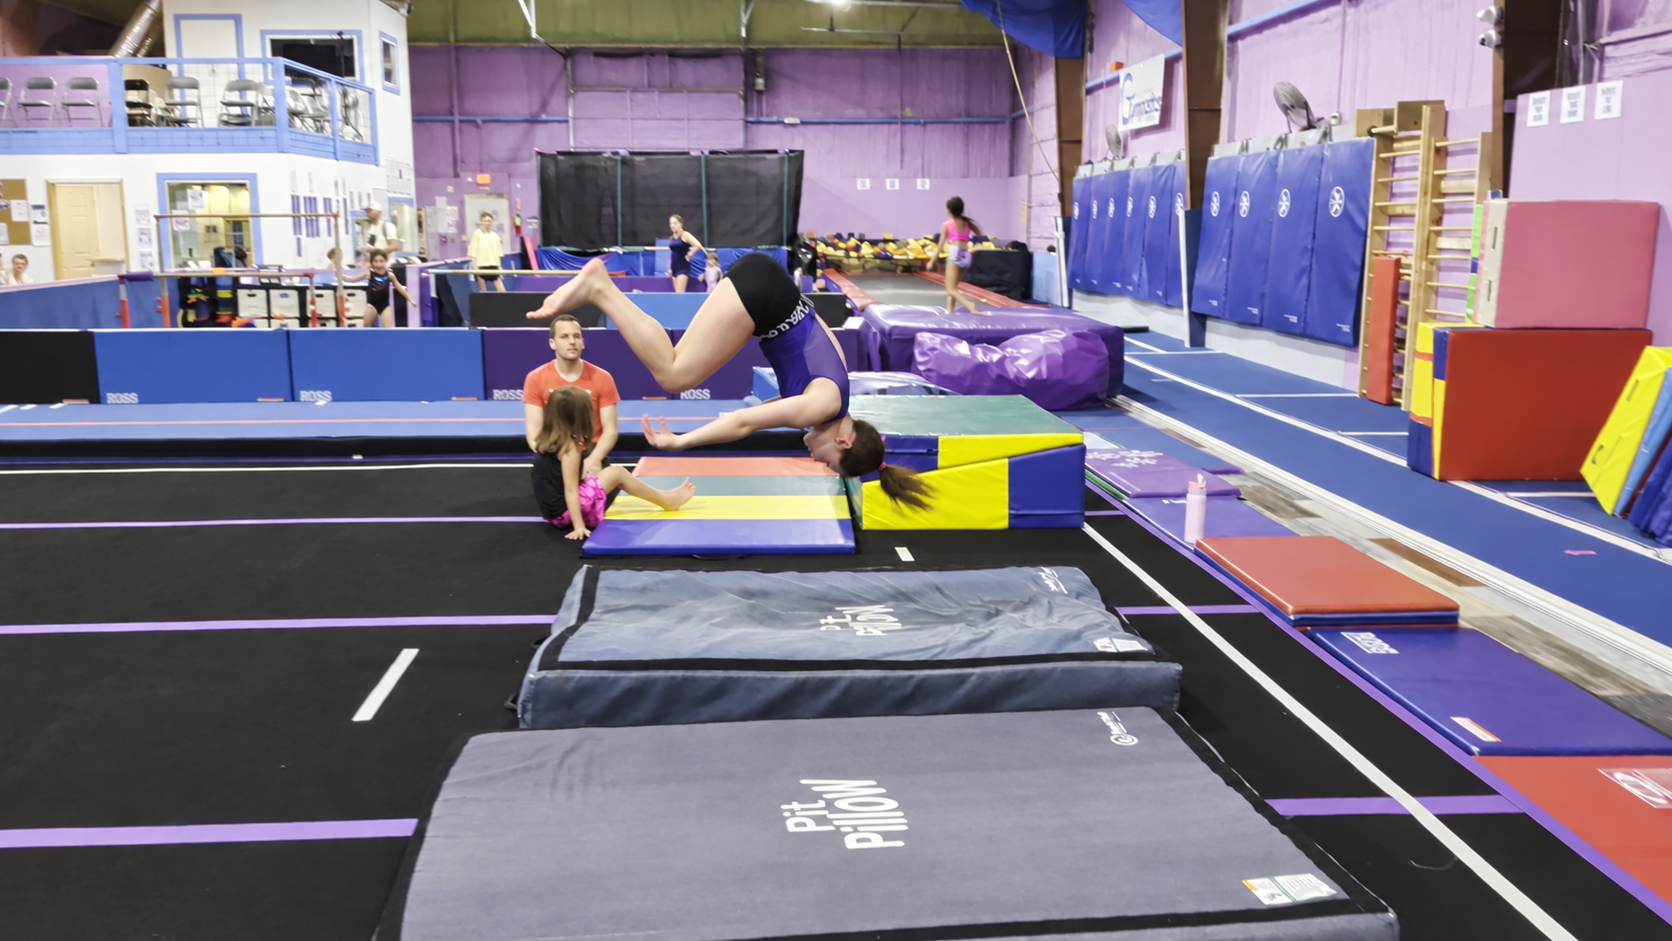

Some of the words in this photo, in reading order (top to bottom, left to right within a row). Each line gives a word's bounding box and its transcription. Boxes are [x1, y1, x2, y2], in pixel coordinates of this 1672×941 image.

[106, 392, 139, 404] ROSS
[300, 390, 332, 402] ROSS
[493, 389, 524, 400] ROSS
[781, 799, 836, 832] Pit
